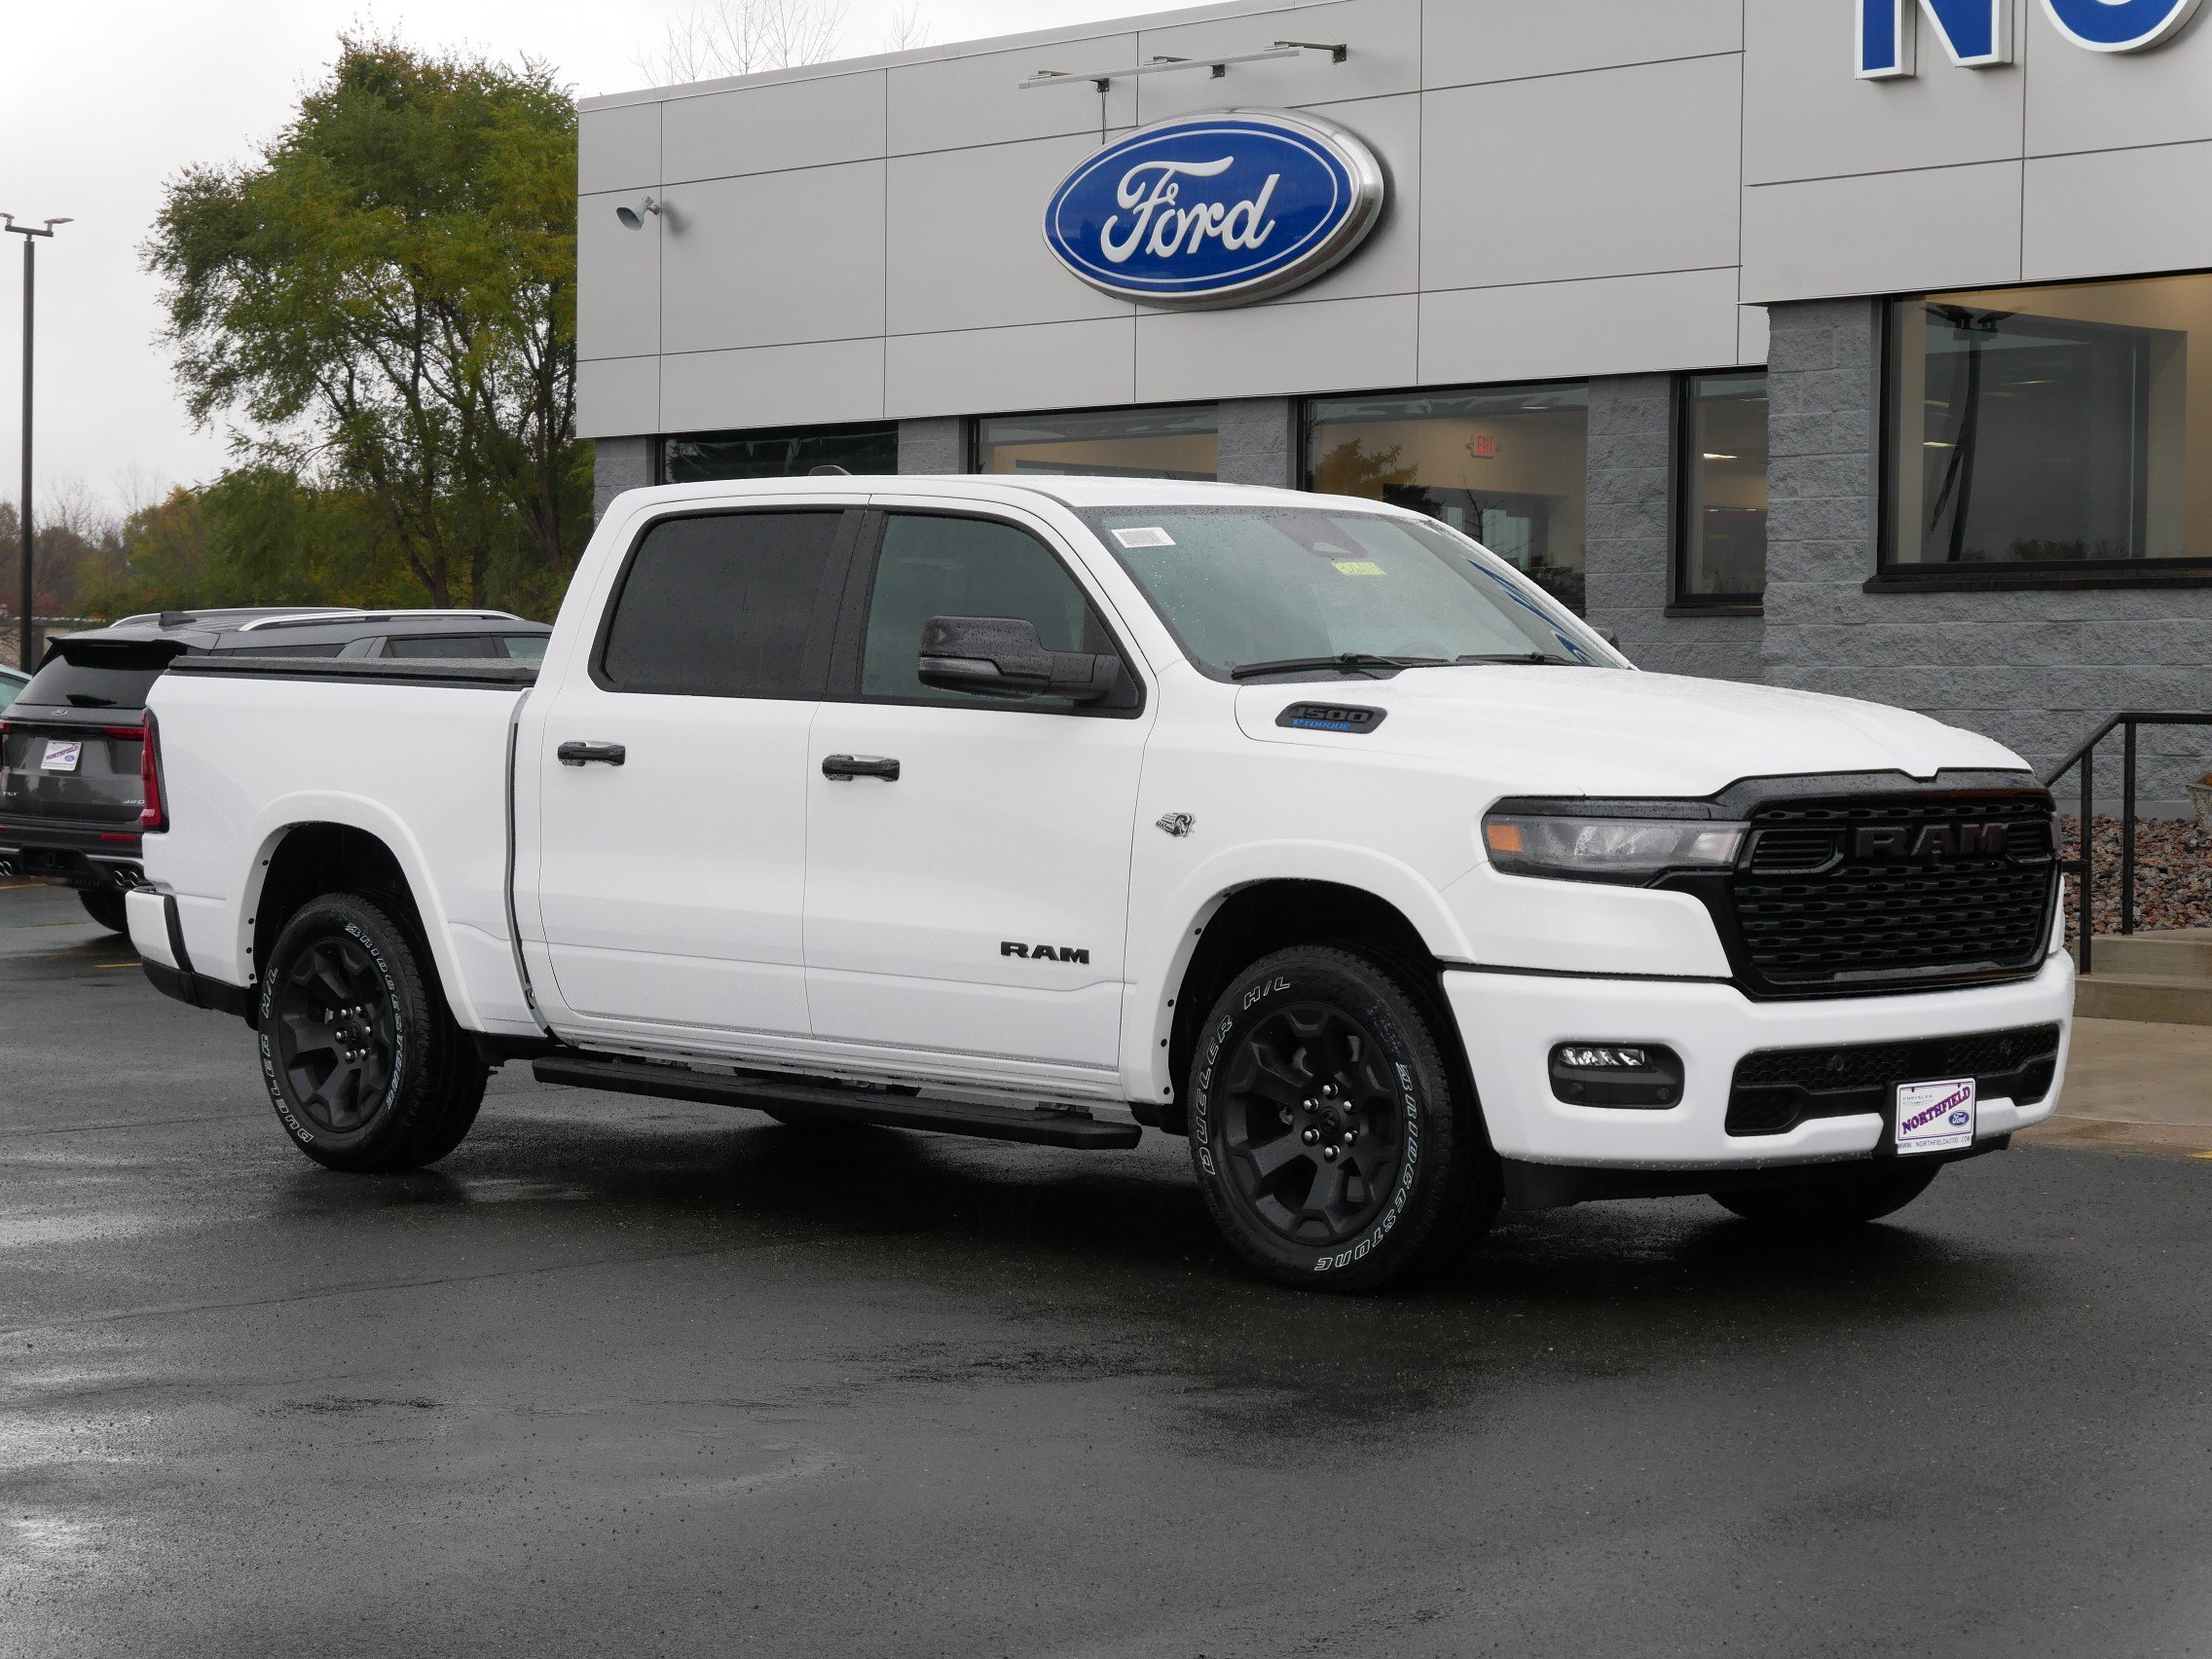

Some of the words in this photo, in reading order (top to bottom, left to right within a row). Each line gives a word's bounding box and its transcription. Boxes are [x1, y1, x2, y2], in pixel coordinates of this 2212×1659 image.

[1100, 156, 1281, 263] Ford
[1476, 435, 1494, 456] EXIT
[1288, 707, 1371, 721] 1500
[1855, 824, 2008, 858] RAM
[1000, 940, 1089, 965] RAM
[1195, 1014, 1234, 1175] DUELER
[1243, 977, 1291, 1011] H/L
[1901, 1087, 1971, 1134] NORTHFIELD
[1952, 1112, 1967, 1124] Ford
[1314, 1061, 1419, 1272] BRIDGESTONE
